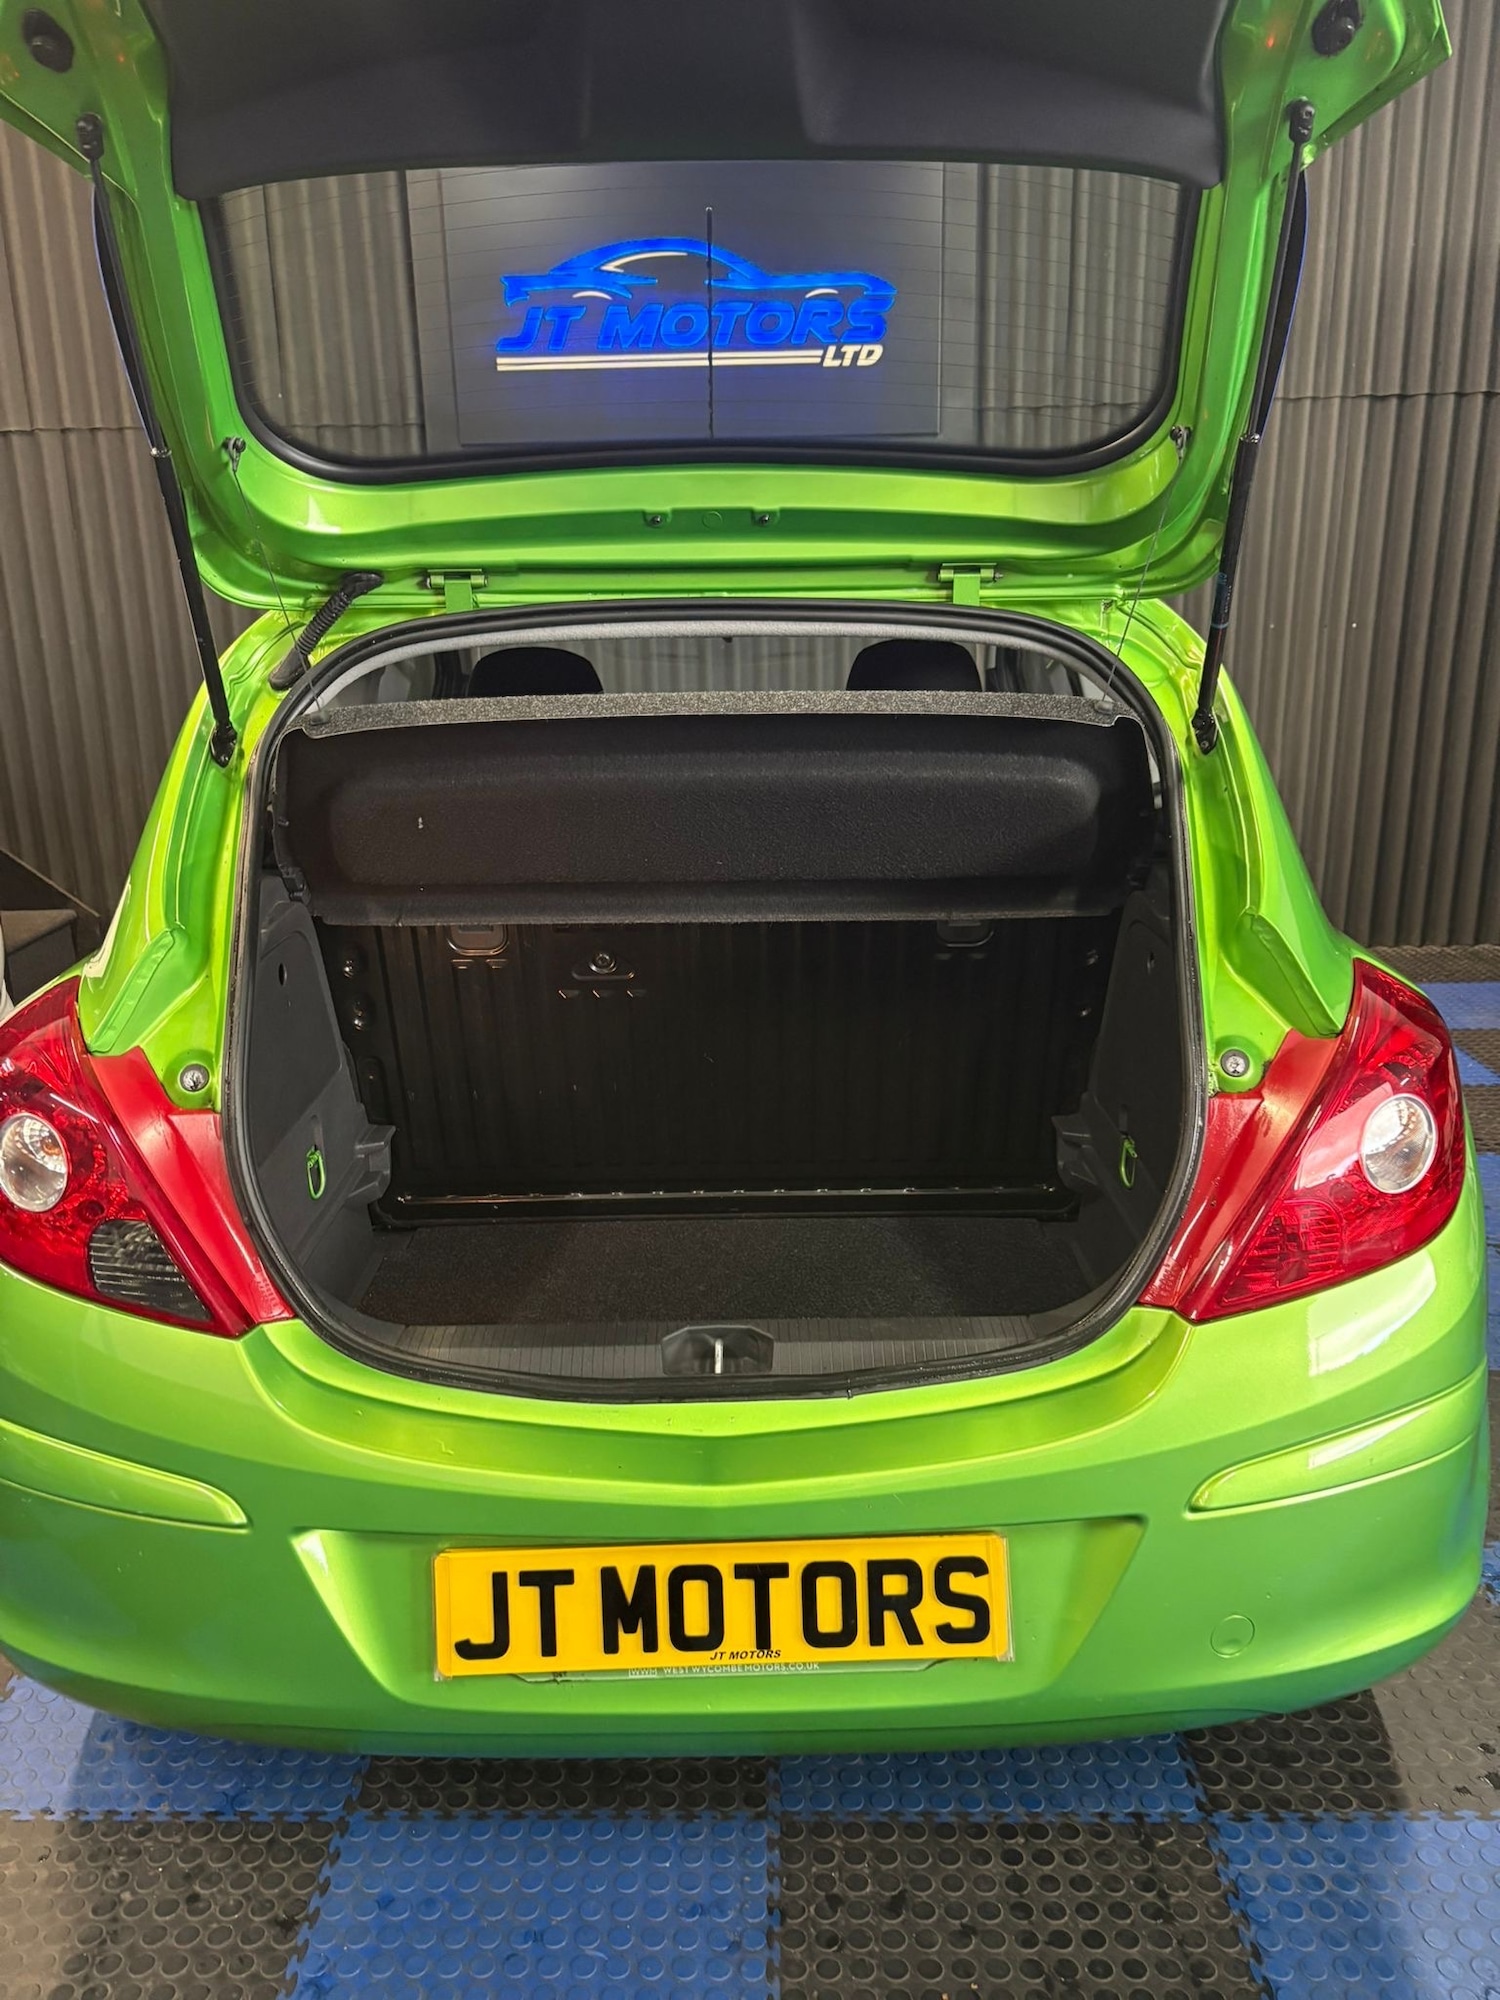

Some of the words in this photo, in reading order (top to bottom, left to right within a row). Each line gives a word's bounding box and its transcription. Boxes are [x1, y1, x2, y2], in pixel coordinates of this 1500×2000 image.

[496, 304, 587, 351] JT
[597, 294, 896, 351] MOTORS
[822, 344, 884, 368] LTD
[454, 1569, 575, 1661] JT
[600, 1555, 991, 1654] MOTORS
[710, 1651, 727, 1661] JT
[729, 1650, 781, 1660] MOTORS
